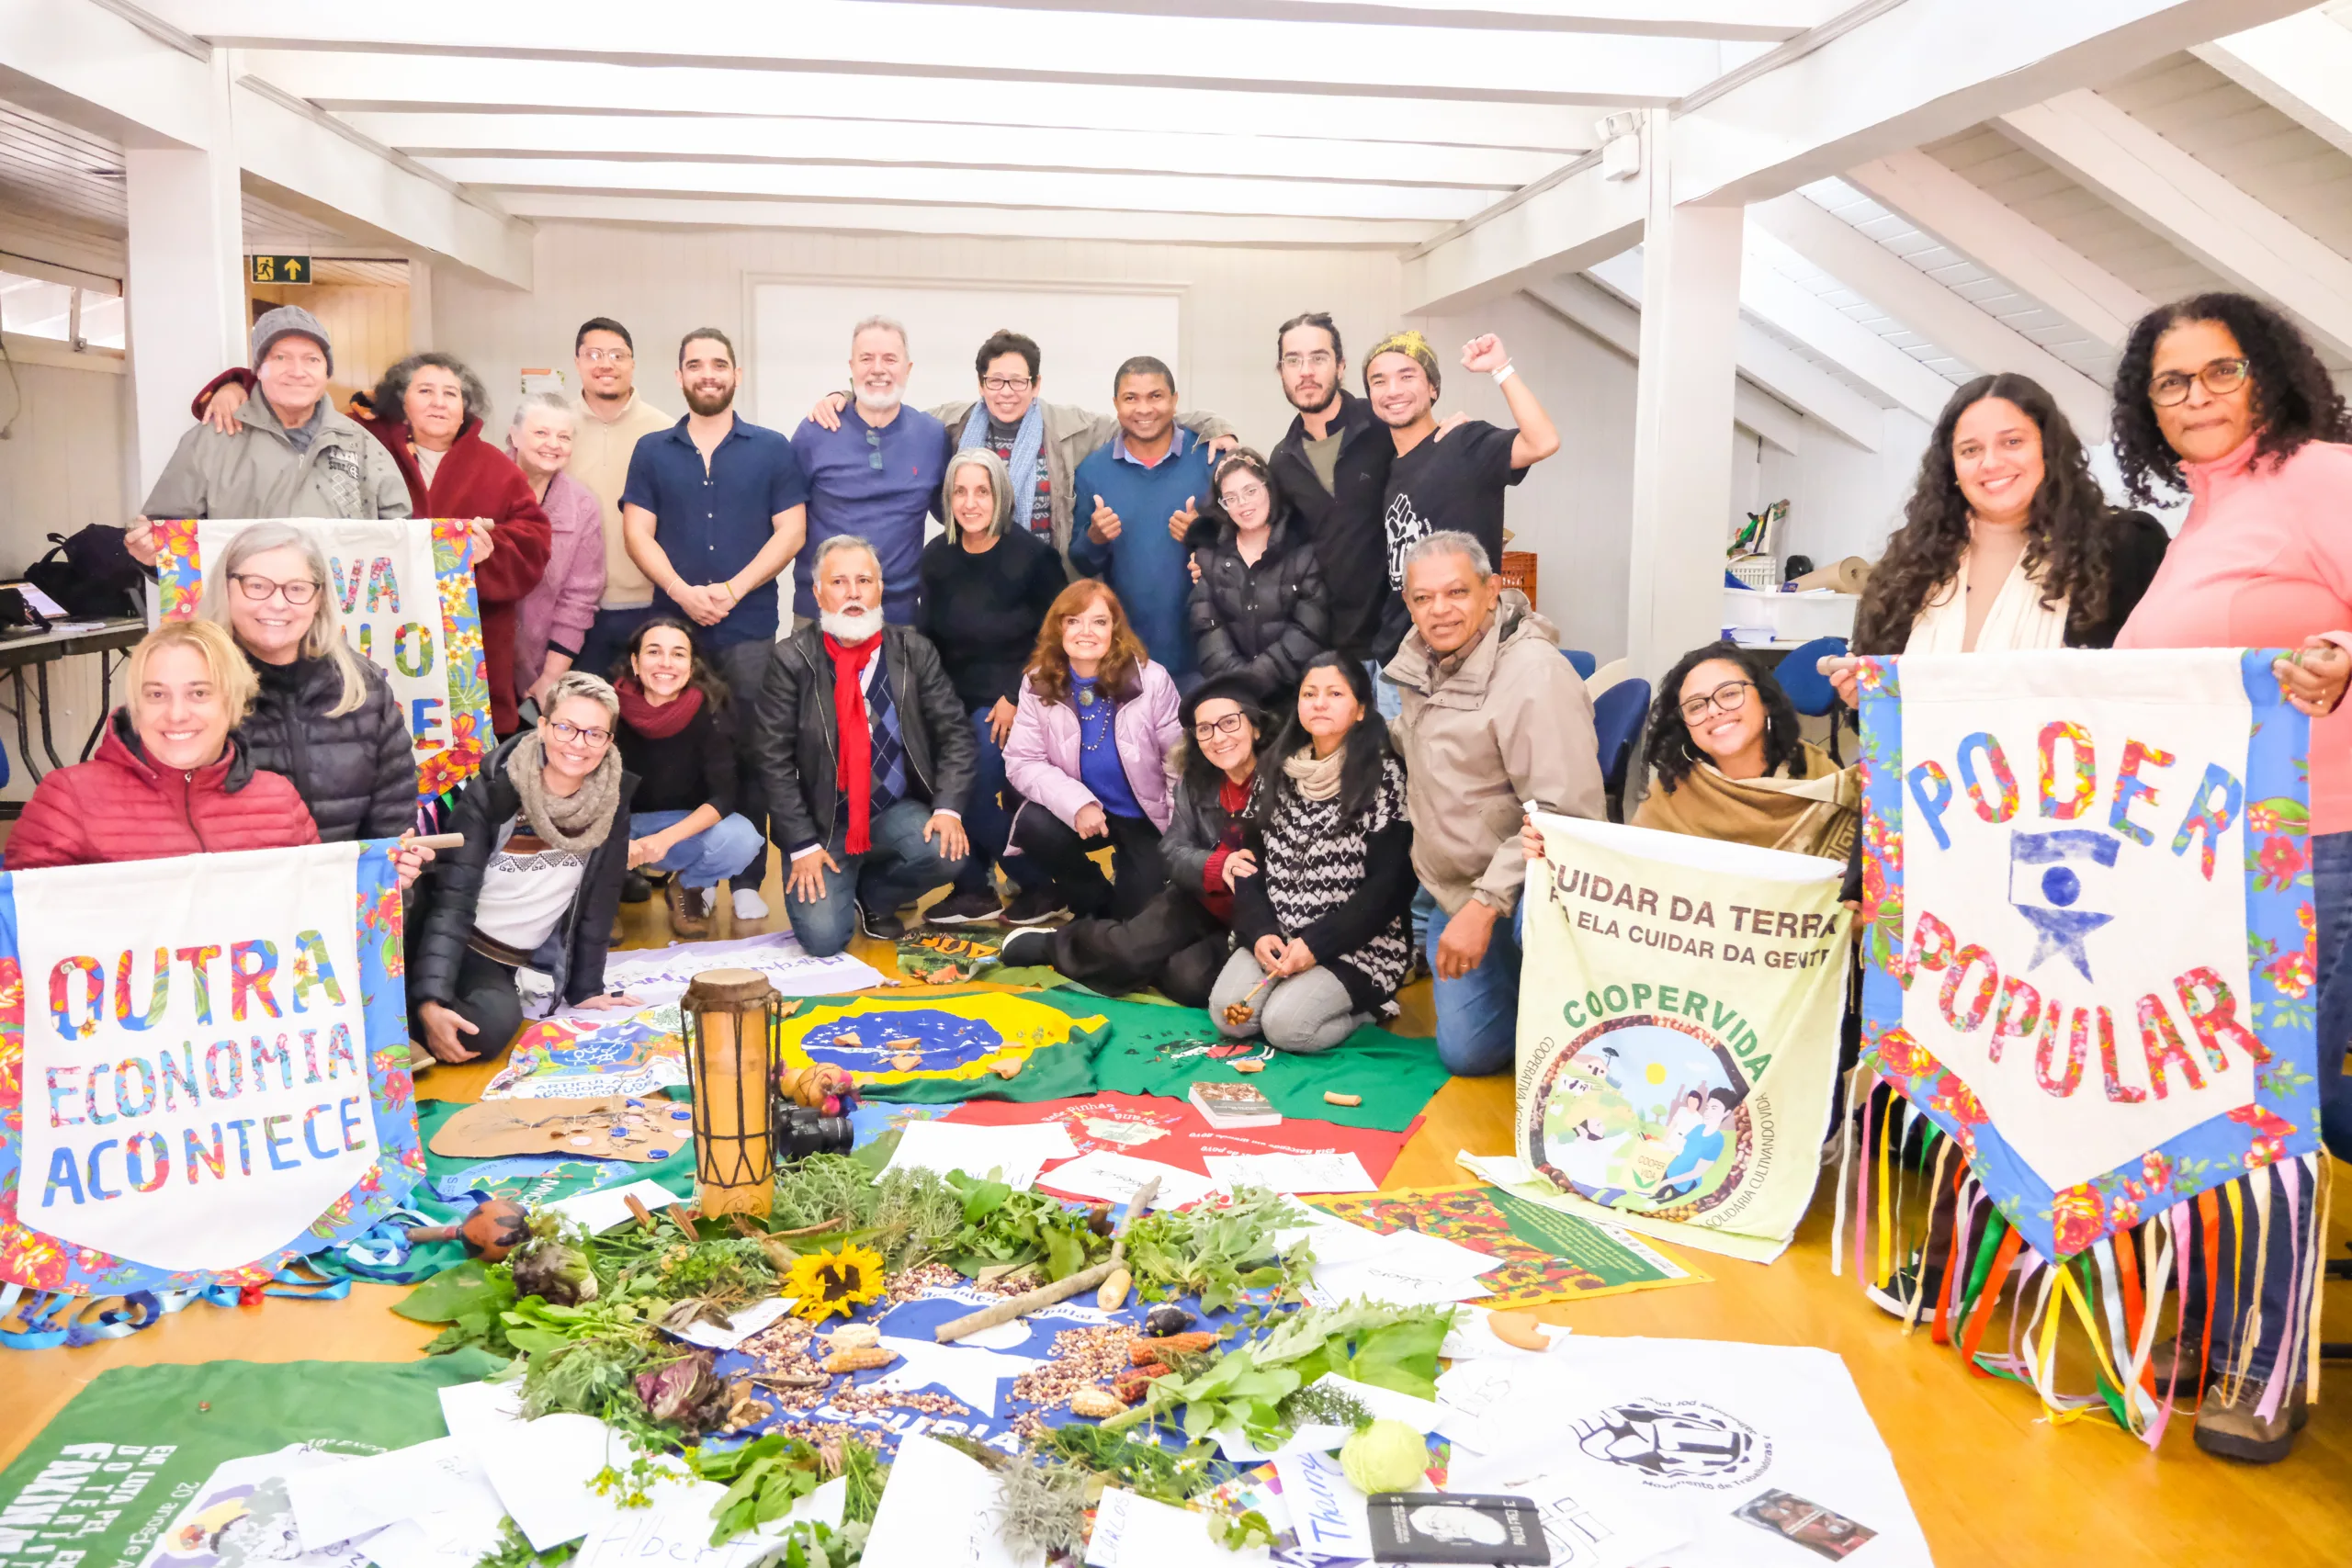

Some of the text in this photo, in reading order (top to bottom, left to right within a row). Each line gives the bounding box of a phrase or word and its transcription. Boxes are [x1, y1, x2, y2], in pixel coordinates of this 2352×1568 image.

[1905, 720, 2245, 882] PODER
[1577, 910, 1620, 939] ELA
[1628, 925, 1714, 960] CUIDAR
[1723, 943, 1756, 964] DA
[1669, 895, 1715, 929] DA
[1729, 905, 1838, 939] TERRA
[48, 929, 346, 1042] OUTRA
[1902, 910, 2274, 1104] POPULAR
[1562, 983, 1774, 1084] COOPERVIDA
[45, 1021, 359, 1129] ECONOMIA
[1515, 1035, 1555, 1101] COOPERATIVA
[1755, 1091, 1771, 1119] VIDA
[41, 1096, 367, 1208] ACONTECE
[1749, 1119, 1775, 1189] CULTIVANDO
[1033, 1307, 1096, 1320] opular
[139, 1445, 178, 1466] EM
[105, 1472, 156, 1505] LUTA
[171, 1481, 200, 1499] 20
[1502, 1499, 1521, 1526] FREIE
